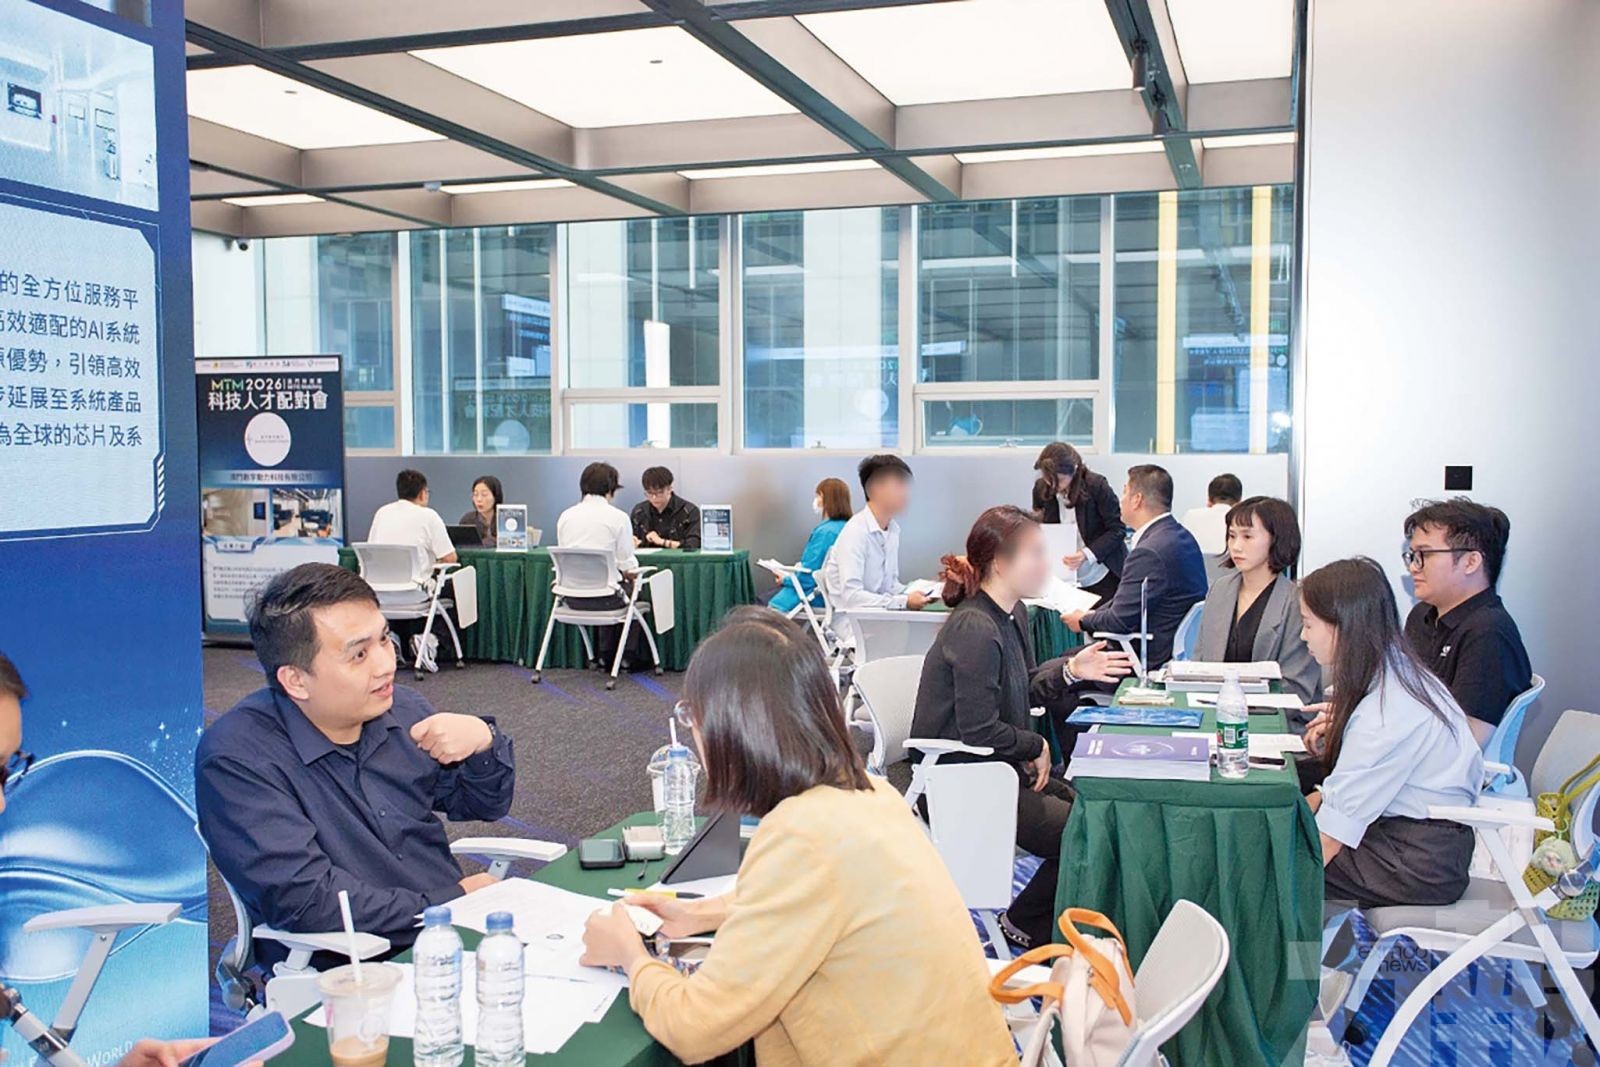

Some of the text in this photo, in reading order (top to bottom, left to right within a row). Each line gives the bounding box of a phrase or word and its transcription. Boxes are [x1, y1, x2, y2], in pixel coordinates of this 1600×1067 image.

[0, 270, 139, 310] 的全方位服務平
[0, 309, 140, 345] 效適配的AI系統
[0, 347, 141, 379] 優勢，引領高效
[245, 377, 282, 390] 2026
[0, 385, 141, 413] 延展至系統產品
[208, 390, 328, 411] 科技人才配對會
